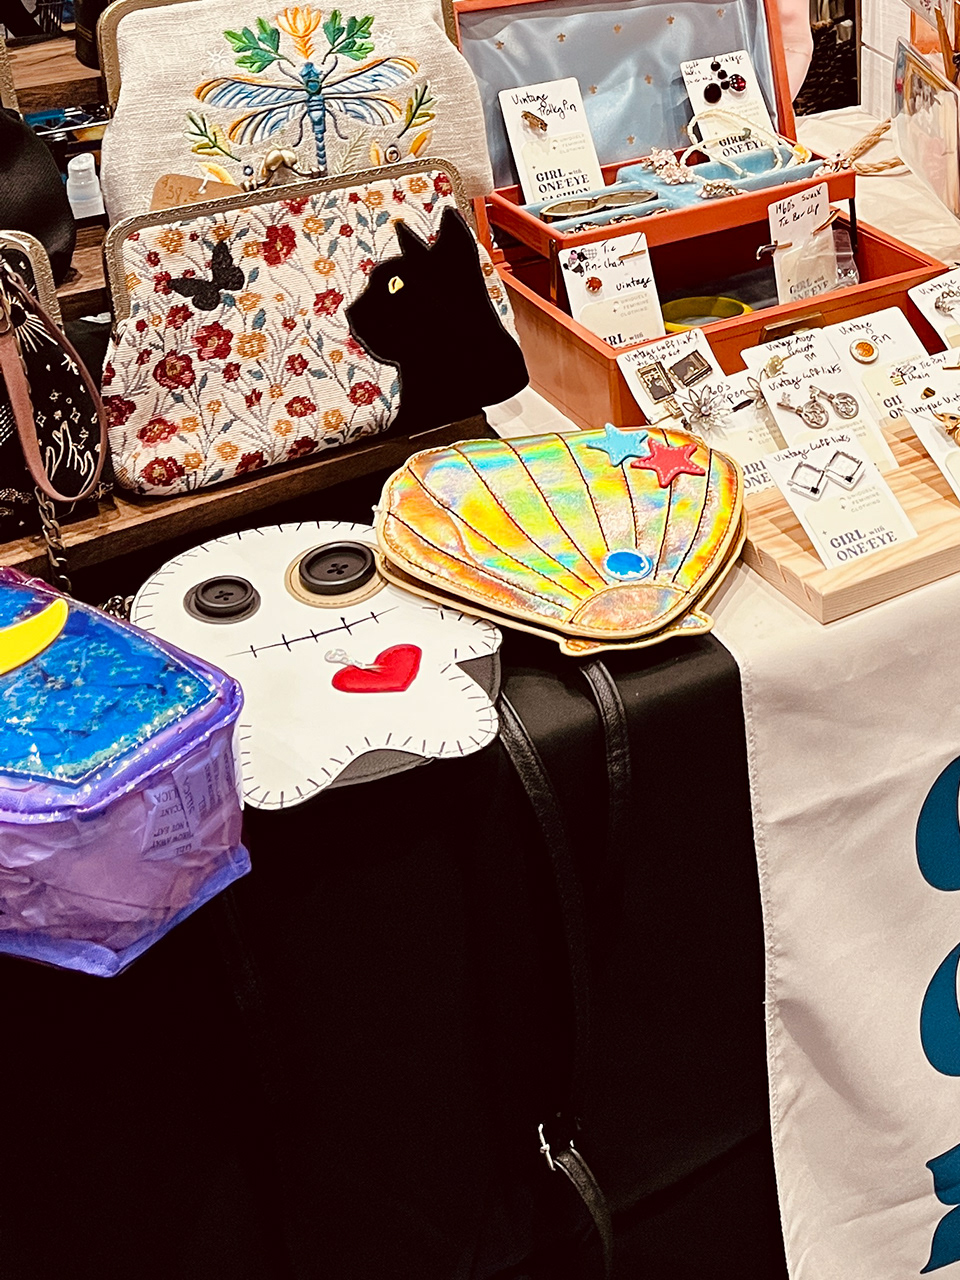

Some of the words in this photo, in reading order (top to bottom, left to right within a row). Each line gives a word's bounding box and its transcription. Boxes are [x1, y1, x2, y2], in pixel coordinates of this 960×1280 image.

[511, 92, 549, 106] Vintage
[722, 144, 745, 157] ONE
[536, 169, 566, 182] GIRL
[538, 179, 565, 193] ONE
[566, 174, 589, 187] EYE
[601, 240, 616, 254] Tie
[919, 278, 957, 295] Vintage
[623, 300, 649, 309] FEMININE
[620, 307, 648, 318] CLOTHING
[839, 322, 873, 334] Vintage
[871, 333, 892, 344] Pin
[624, 347, 656, 362] Vintage
[769, 377, 802, 390] Vintage
[911, 401, 943, 418] Unique
[774, 447, 809, 462] Vintage
[852, 492, 880, 505] FEMININE
[851, 499, 881, 513] CLOTHING
[830, 529, 867, 549] GIRL
[836, 543, 867, 561] ONE
[866, 531, 898, 550] EYE
